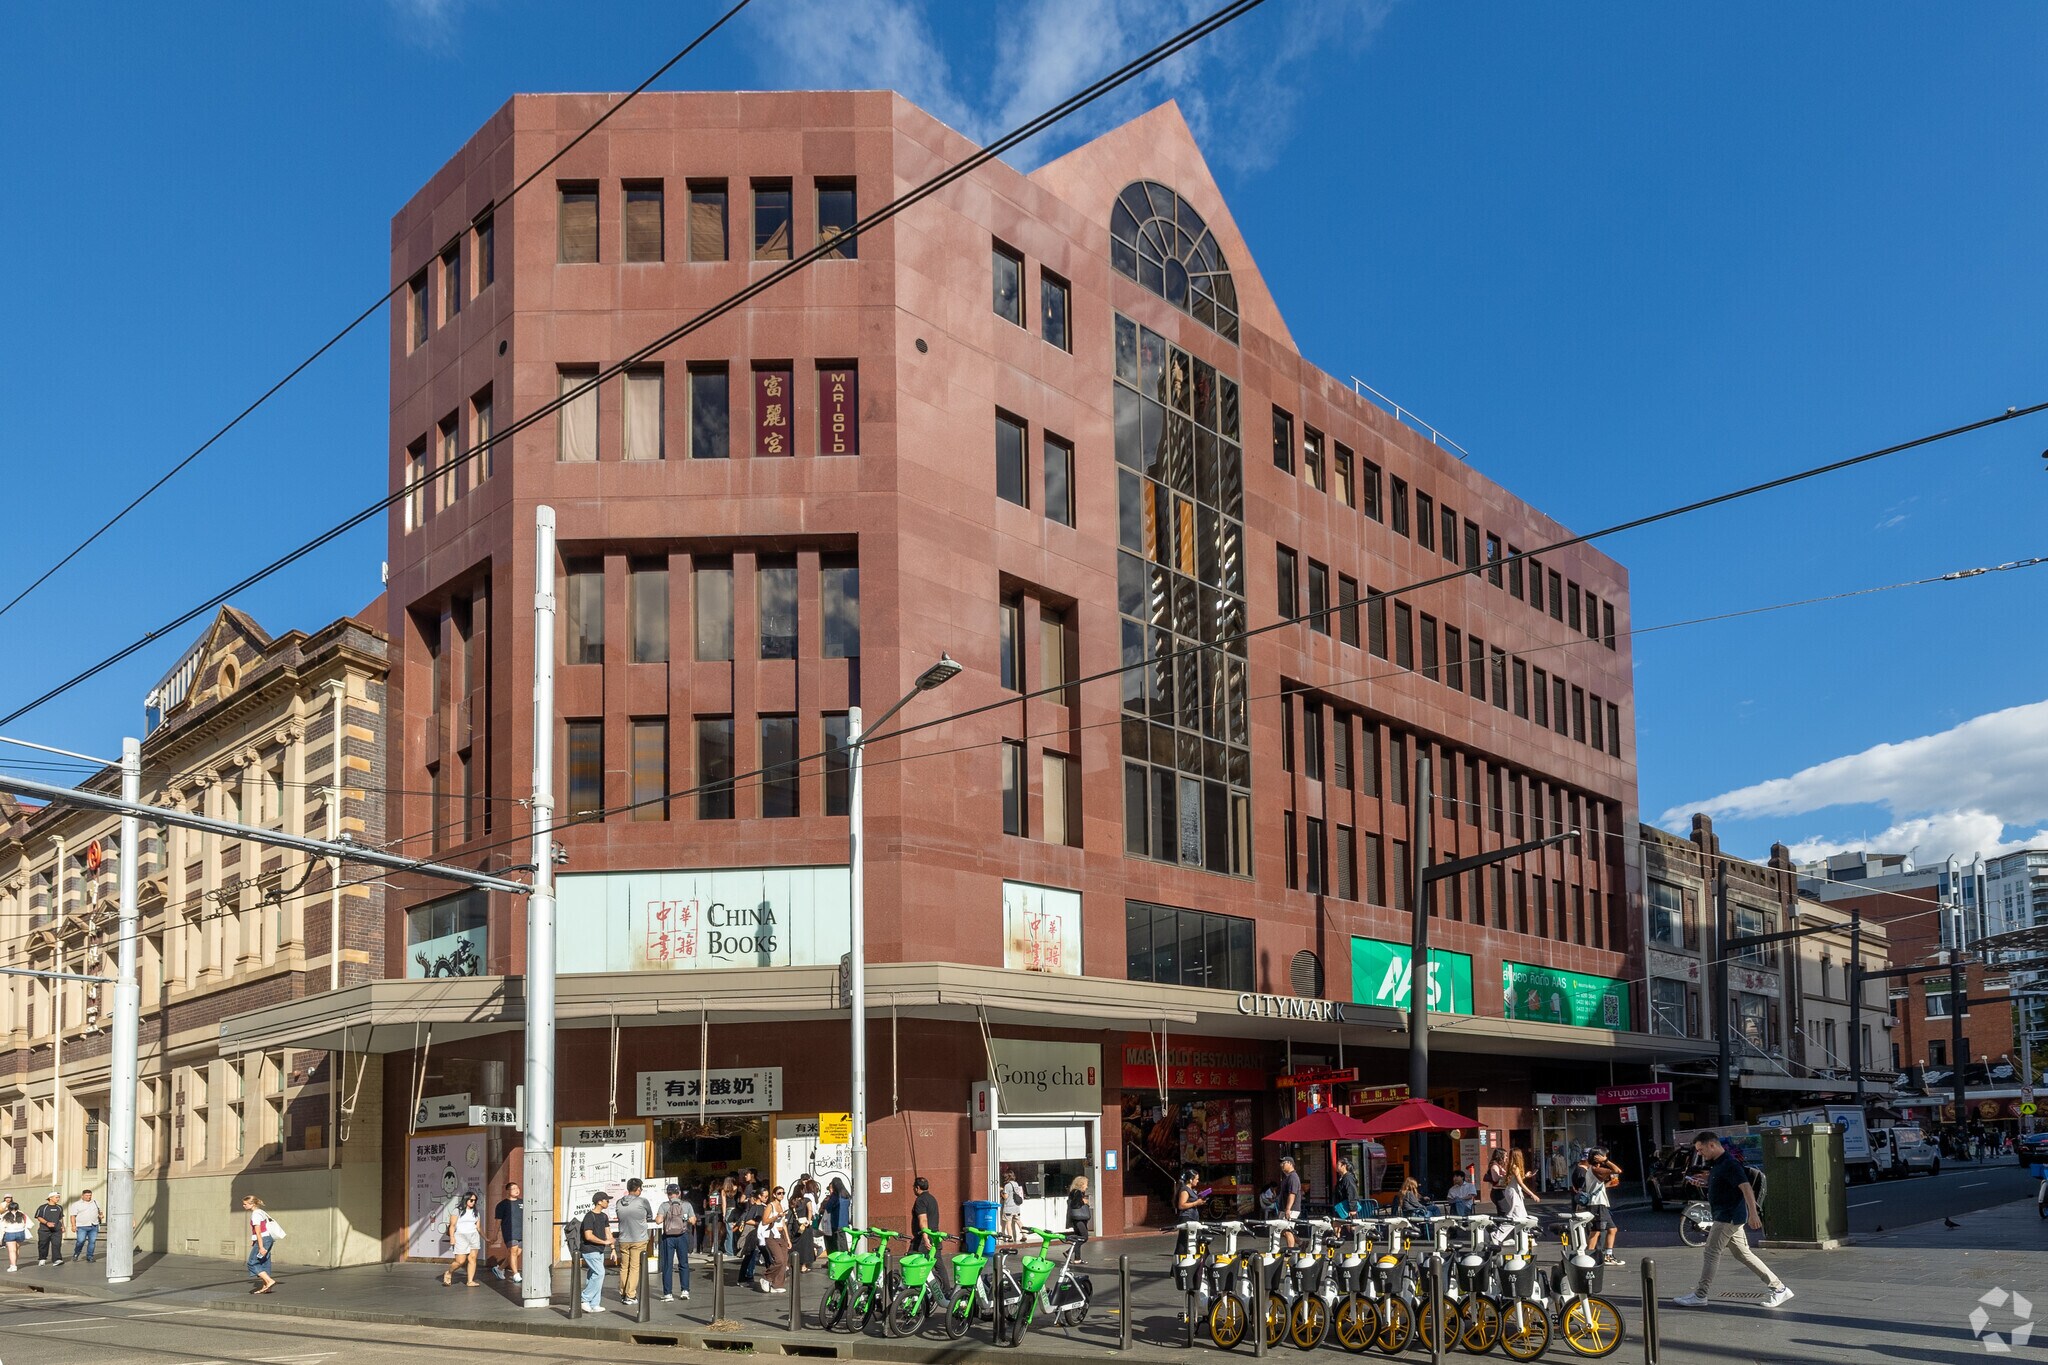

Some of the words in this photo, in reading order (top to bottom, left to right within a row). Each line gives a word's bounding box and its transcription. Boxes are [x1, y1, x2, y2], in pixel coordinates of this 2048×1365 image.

[763, 375, 786, 453] 富麗宮
[831, 373, 846, 453] MARIGOLD
[1551, 977, 1567, 989] AAS
[1238, 993, 1346, 1022] CITYMARK
[1126, 1048, 1191, 1066] MARGOLD
[1193, 1050, 1265, 1069] RESTAURANT
[994, 1064, 1047, 1092] Gong
[1052, 1066, 1084, 1086] cha
[1294, 1071, 1352, 1083] MARIGOLD
[664, 1078, 754, 1096] 有米酸奶
[1608, 1088, 1639, 1098] STUDIO
[1640, 1087, 1668, 1096] SEOUL
[728, 1098, 754, 1106] Yogurt
[491, 1111, 515, 1122] 有米酸
[579, 1129, 627, 1139] 有米酸奶
[918, 1128, 933, 1137] 223
[417, 1144, 446, 1155] 有米酸奶
